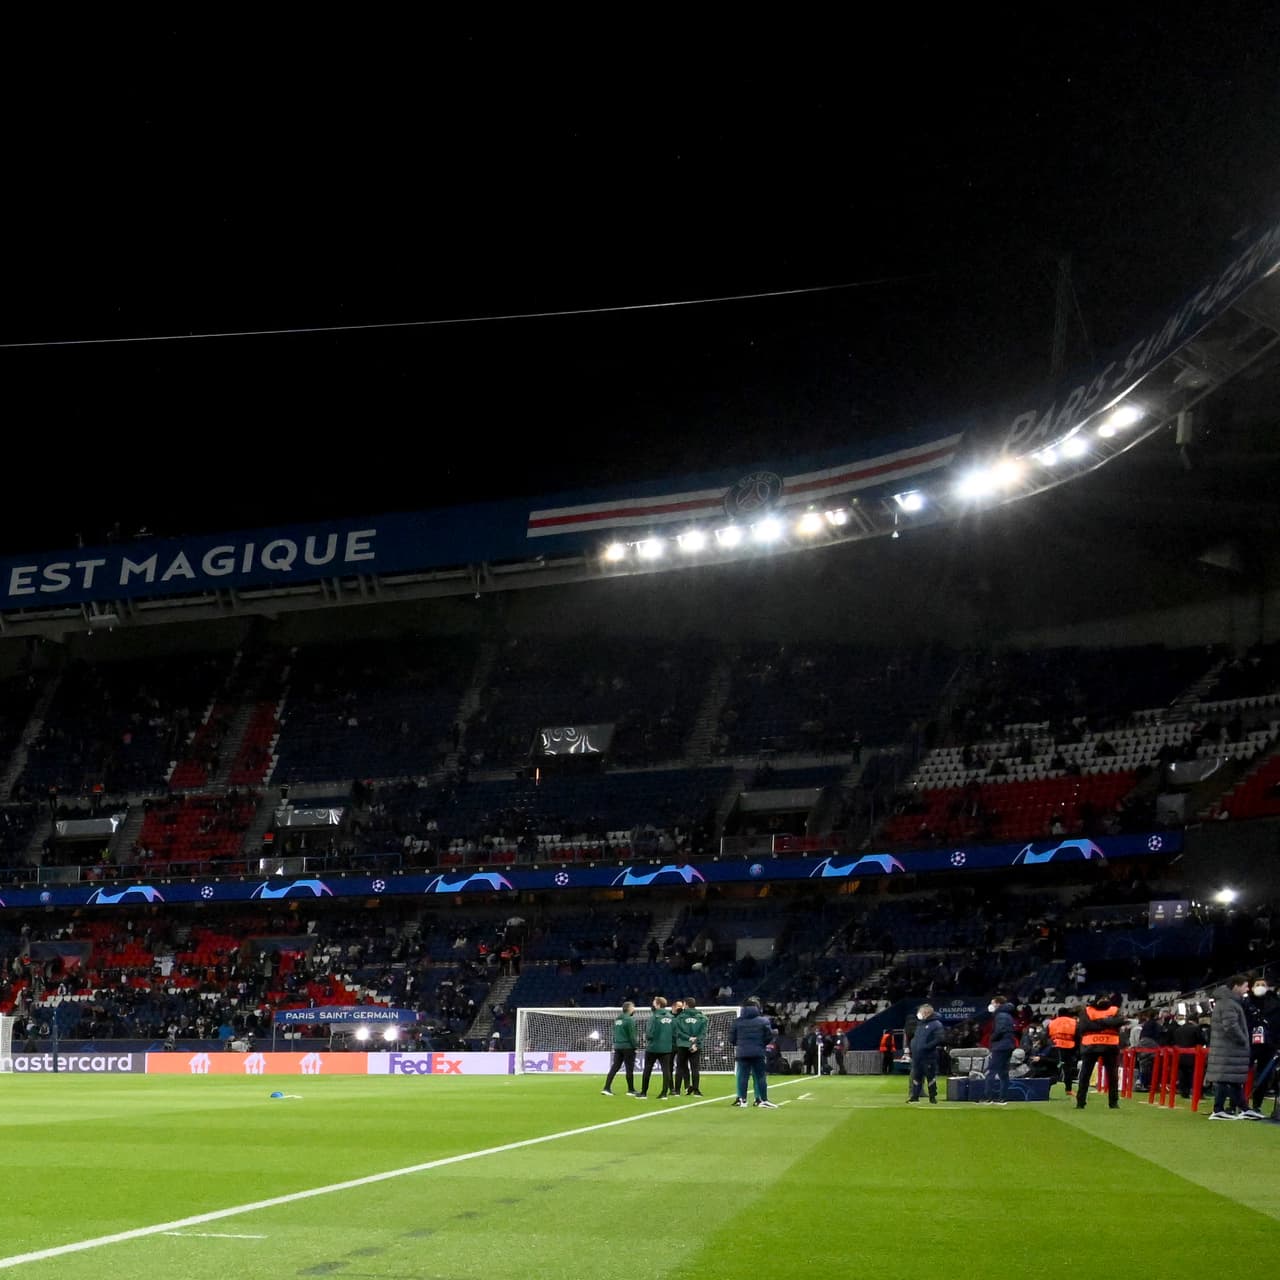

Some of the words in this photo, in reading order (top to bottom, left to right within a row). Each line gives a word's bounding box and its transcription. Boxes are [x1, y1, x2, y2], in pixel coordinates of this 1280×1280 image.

[7, 558, 106, 596] EST
[119, 529, 377, 586] MAGIQUE
[285, 1012, 316, 1020] PARIS
[319, 1011, 399, 1019] SAINT-GERMAIN
[389, 1055, 462, 1075] FedEx
